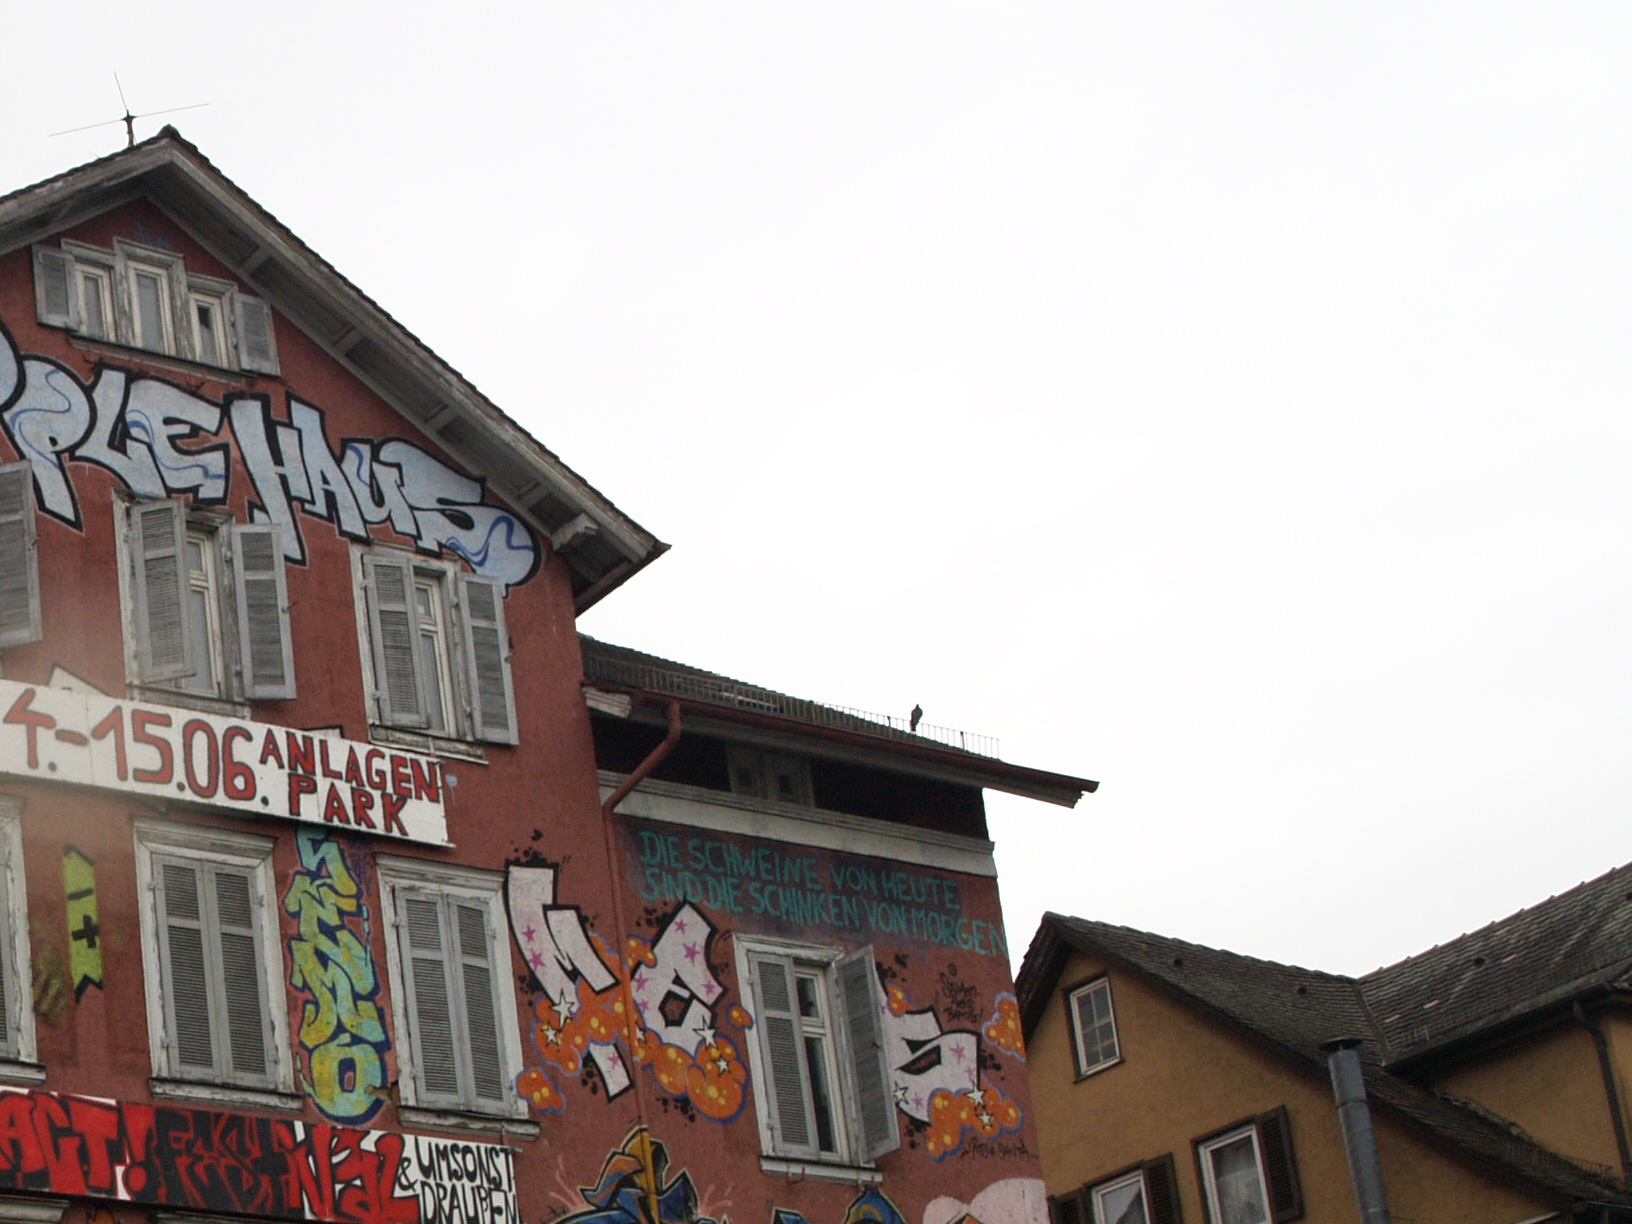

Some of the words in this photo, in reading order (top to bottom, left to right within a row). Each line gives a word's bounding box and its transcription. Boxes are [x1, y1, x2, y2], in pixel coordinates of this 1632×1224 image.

[258, 727, 443, 804] ANLAGEN
[287, 771, 411, 838] PARK
[639, 832, 680, 864] DIE
[688, 836, 824, 890] SCHWEINE
[830, 864, 878, 892] VON
[883, 870, 960, 910] HEUTE
[639, 865, 705, 902] SIND
[751, 883, 860, 927] SCHINKEN
[868, 901, 909, 934] VON
[911, 907, 1008, 958] MORGEN
[414, 1135, 517, 1193] UMSONST
